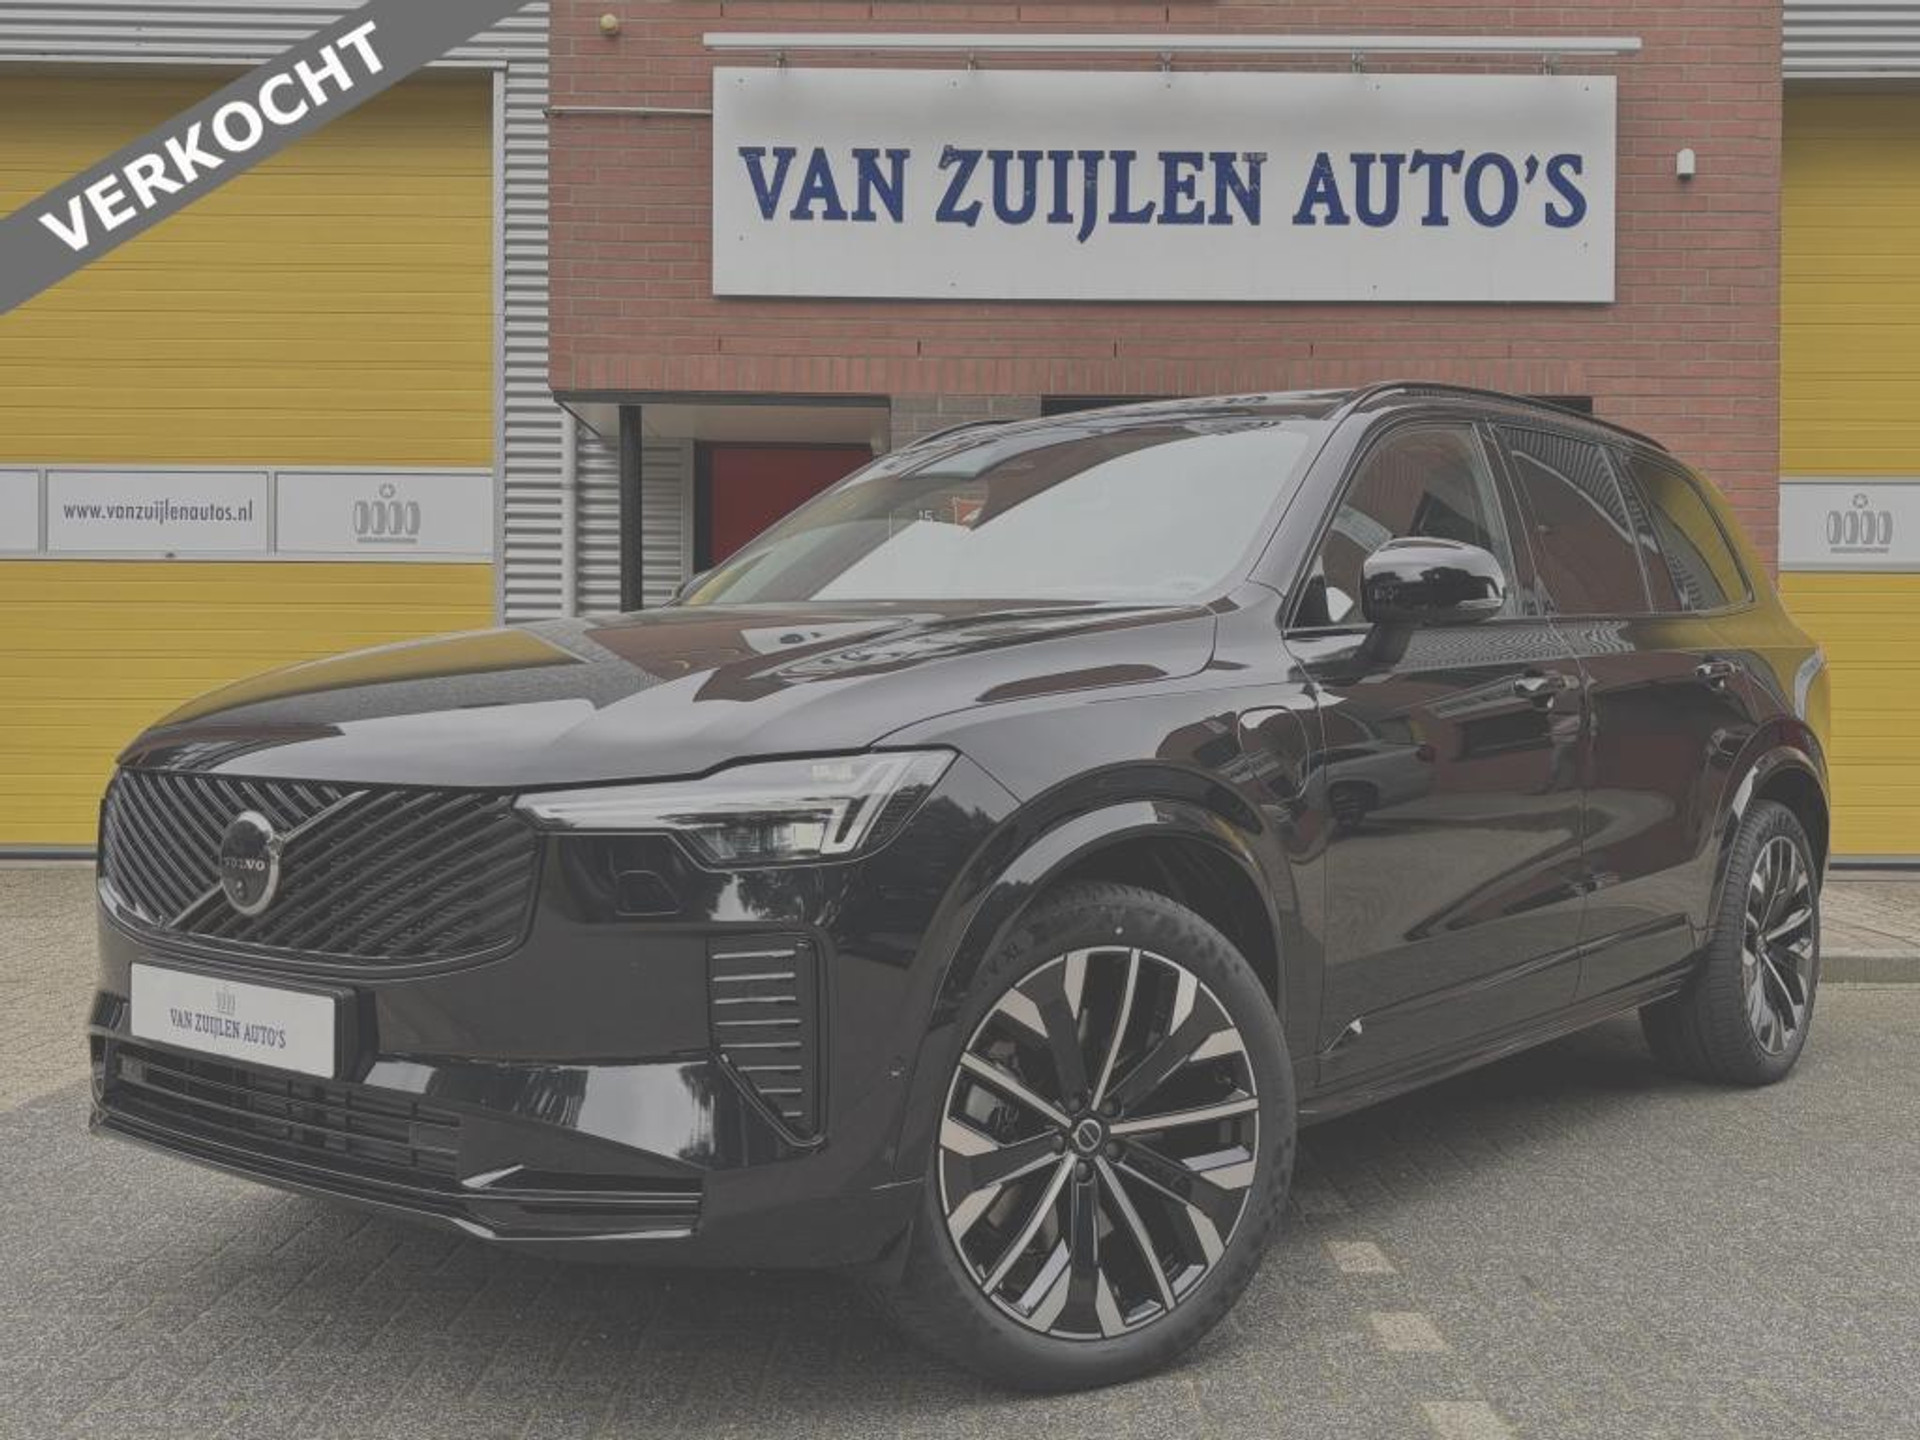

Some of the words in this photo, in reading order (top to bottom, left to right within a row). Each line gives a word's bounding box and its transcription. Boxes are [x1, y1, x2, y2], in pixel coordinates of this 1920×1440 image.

[738, 146, 911, 223] VAN
[936, 145, 1268, 243] ZUIJLEN
[1292, 149, 1587, 228] AUTO'S
[63, 499, 253, 525] www.vanzuijlenautos.nl
[170, 1008, 193, 1029] VAN
[195, 1013, 241, 1040] ZUIJLEN
[243, 1024, 286, 1049] AUTO'S
